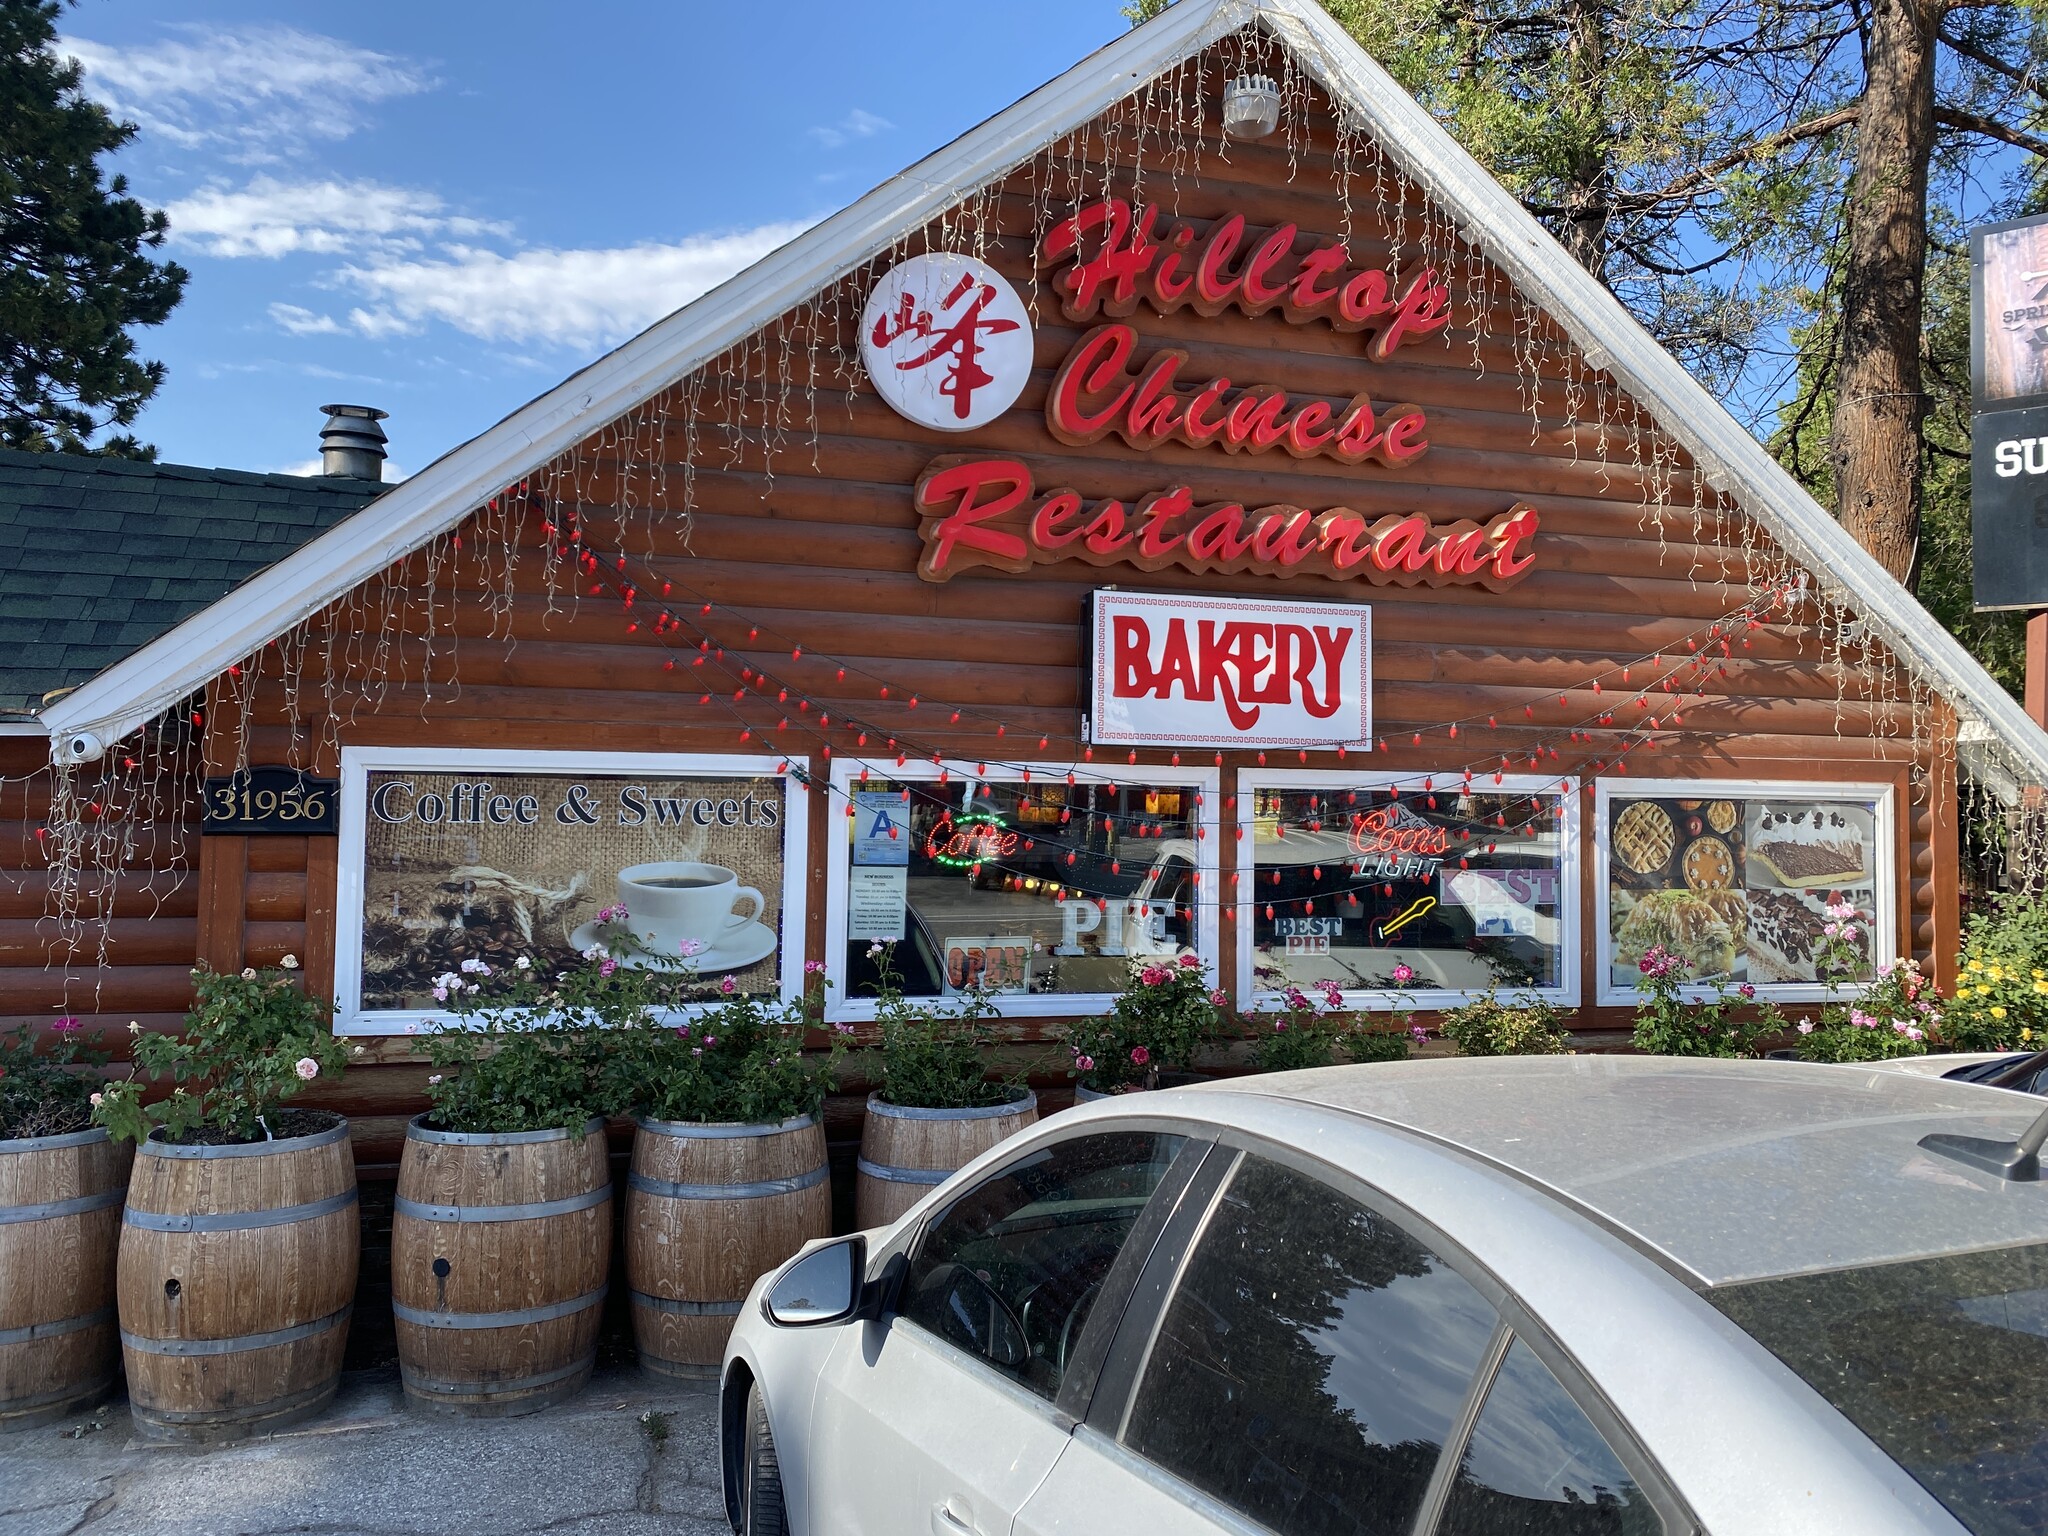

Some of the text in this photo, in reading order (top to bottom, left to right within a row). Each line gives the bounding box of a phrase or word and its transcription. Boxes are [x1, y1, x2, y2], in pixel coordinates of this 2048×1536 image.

[1042, 199, 1452, 358] Hilltop
[2003, 304, 2048, 324] SPRI
[1054, 323, 1428, 461] Chinese
[920, 459, 1539, 578] Restaurant
[1113, 615, 1353, 731] BAKERY
[211, 788, 326, 820] 31956
[371, 781, 779, 829] Coffee & Sweets
[869, 810, 892, 838] A
[926, 820, 1018, 856] Coffee
[1356, 811, 1451, 853] Coors
[1360, 857, 1444, 877] LIGHT
[1441, 869, 1560, 904] BEST
[1054, 899, 1177, 956] PIE
[1277, 918, 1341, 936] BEST
[1287, 936, 1328, 954] PIE
[947, 947, 1028, 990] OPEN
